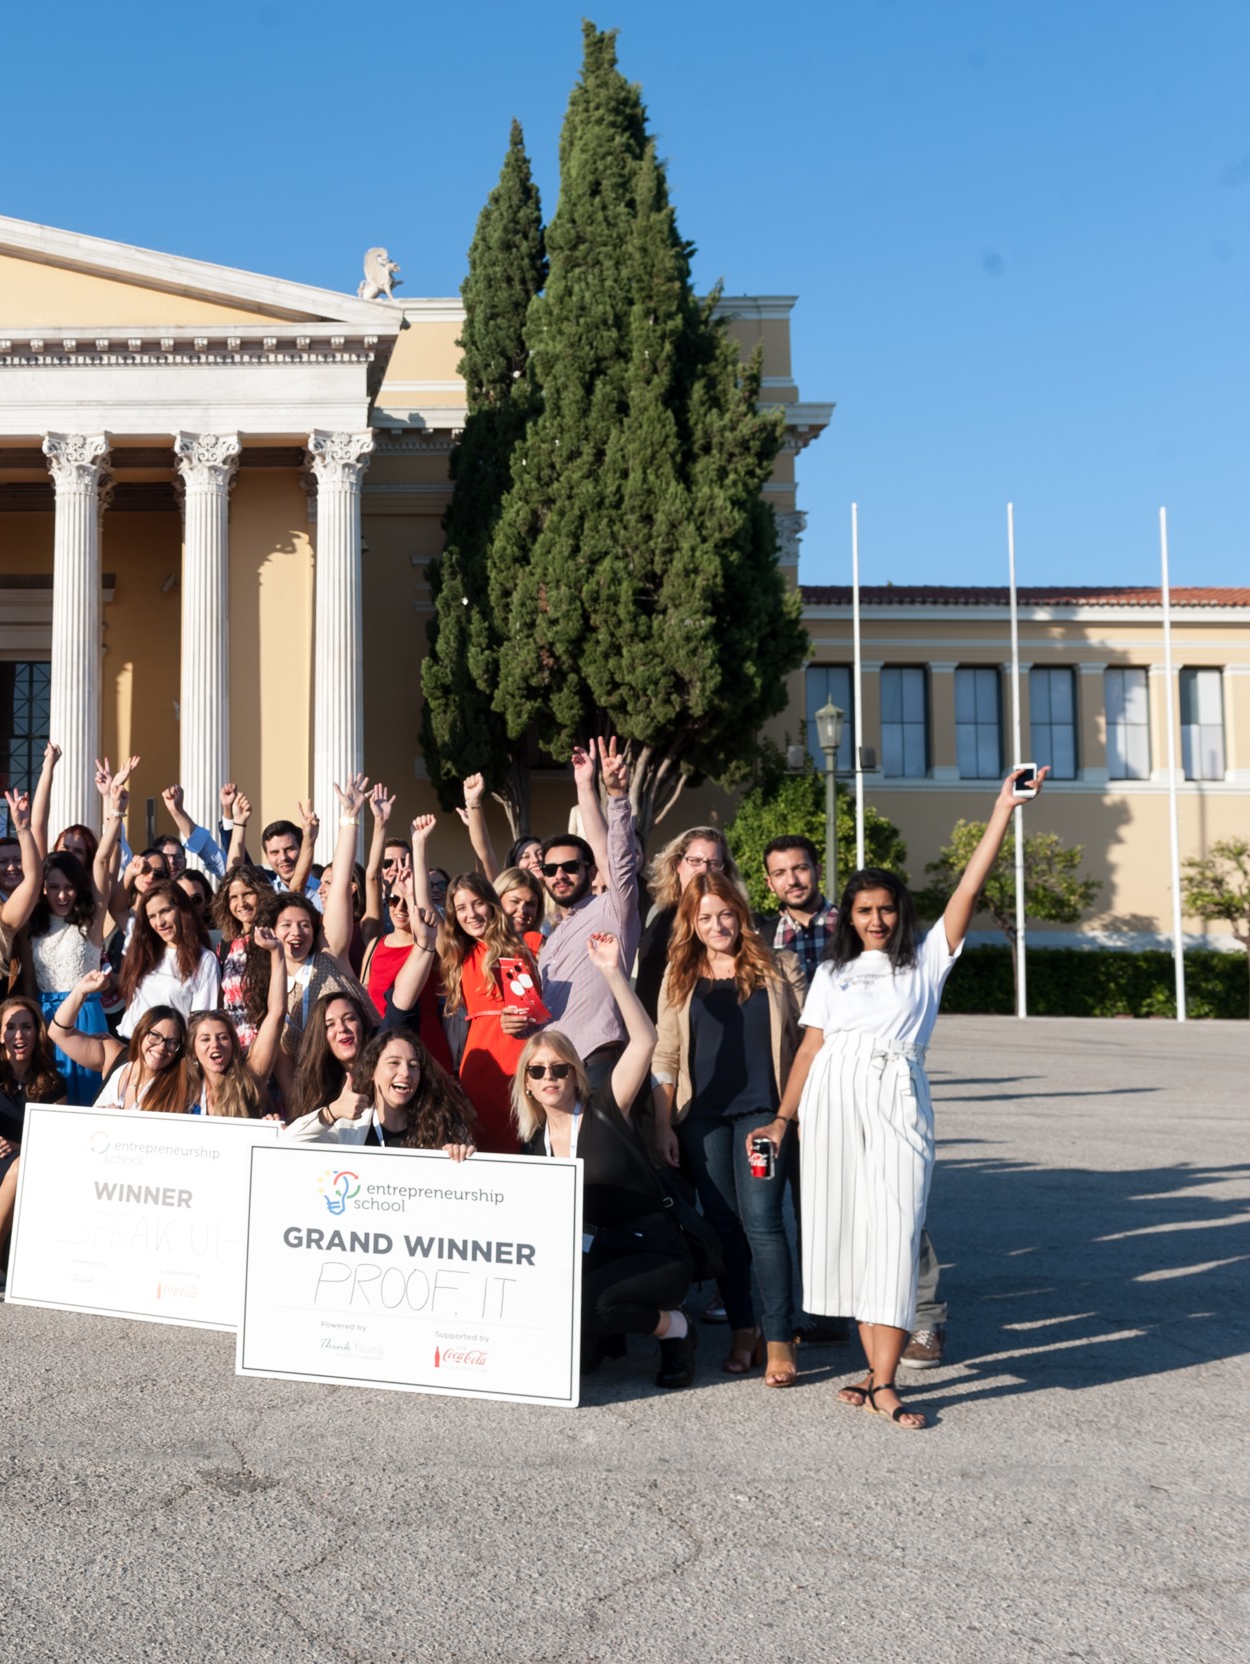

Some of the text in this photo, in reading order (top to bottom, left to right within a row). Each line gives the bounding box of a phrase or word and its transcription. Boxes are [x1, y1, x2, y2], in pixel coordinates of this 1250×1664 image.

[103, 1154, 143, 1167] school
[114, 1141, 221, 1161] entrepreneurship
[94, 1181, 193, 1209] WINNER
[366, 1182, 505, 1205] entrepreneurship
[353, 1196, 405, 1213] school
[283, 1226, 536, 1266] GRAND WINNER
[435, 1331, 477, 1341] Supported
